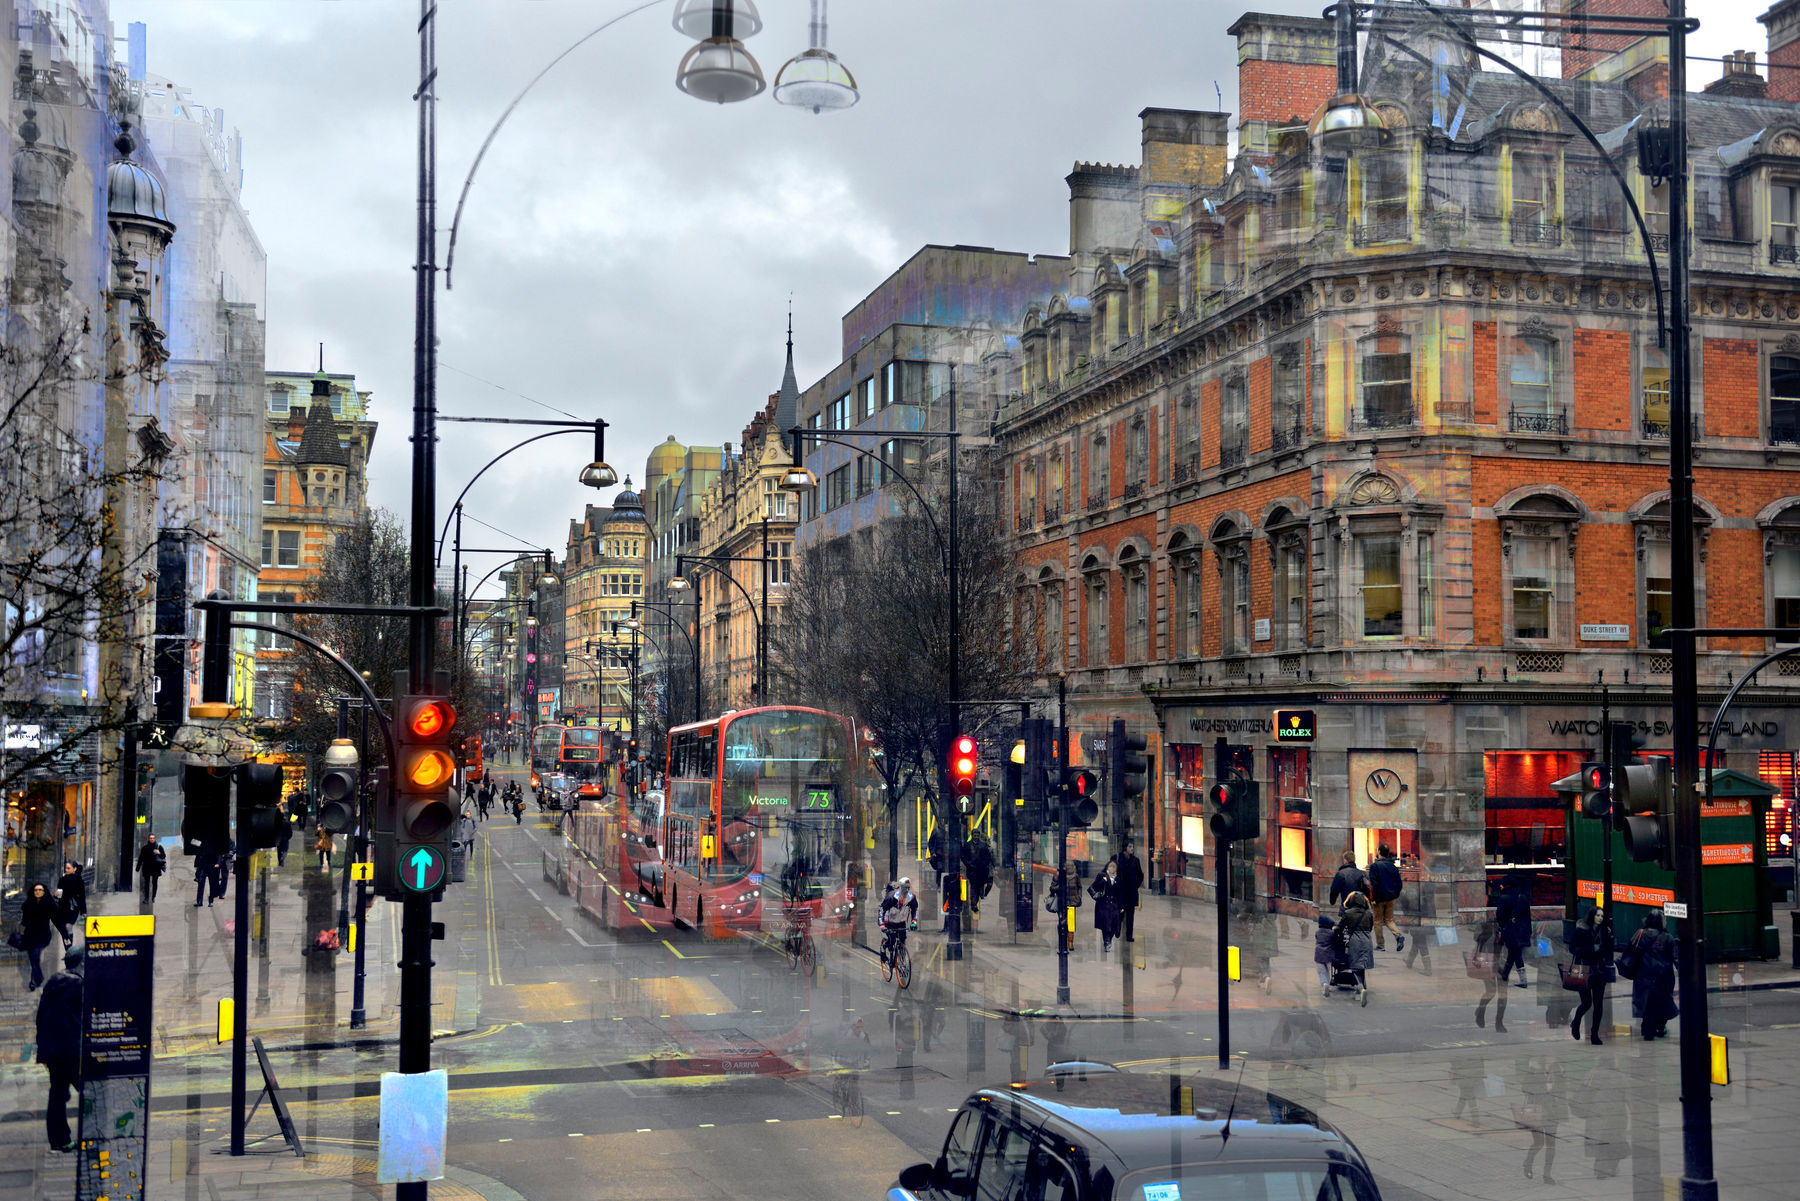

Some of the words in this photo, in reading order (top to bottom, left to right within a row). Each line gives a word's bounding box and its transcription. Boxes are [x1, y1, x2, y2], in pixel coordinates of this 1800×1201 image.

[1548, 720, 1638, 735] WATCHS
[1653, 720, 1778, 736] SWZERLAND
[748, 795, 788, 806] Victoria
[808, 792, 830, 808] 73
[1638, 892, 1645, 900] 50
[1646, 892, 1668, 902] METRES
[88, 950, 114, 958] Oxford
